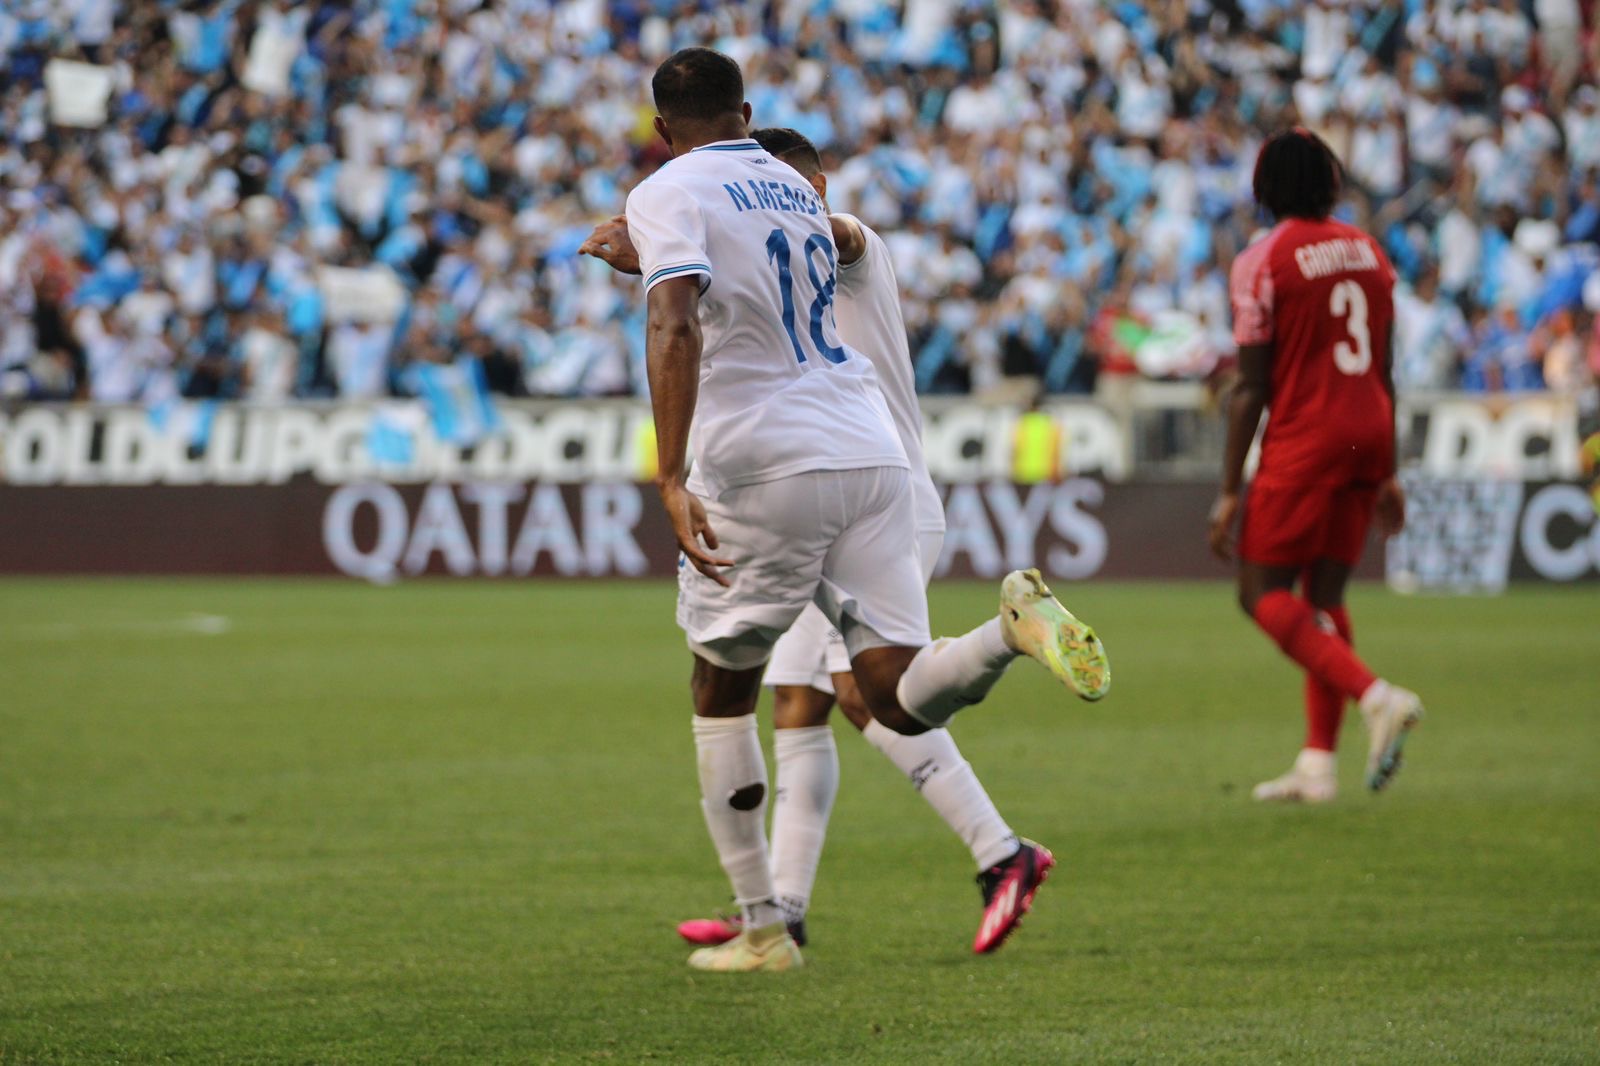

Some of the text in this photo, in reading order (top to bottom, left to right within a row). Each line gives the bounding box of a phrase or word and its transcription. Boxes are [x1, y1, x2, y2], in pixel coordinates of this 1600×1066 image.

[765, 228, 848, 364] 18
[1329, 279, 1372, 376] 3
[322, 477, 1108, 584] QATAR AYS
[1520, 483, 1600, 581] C
